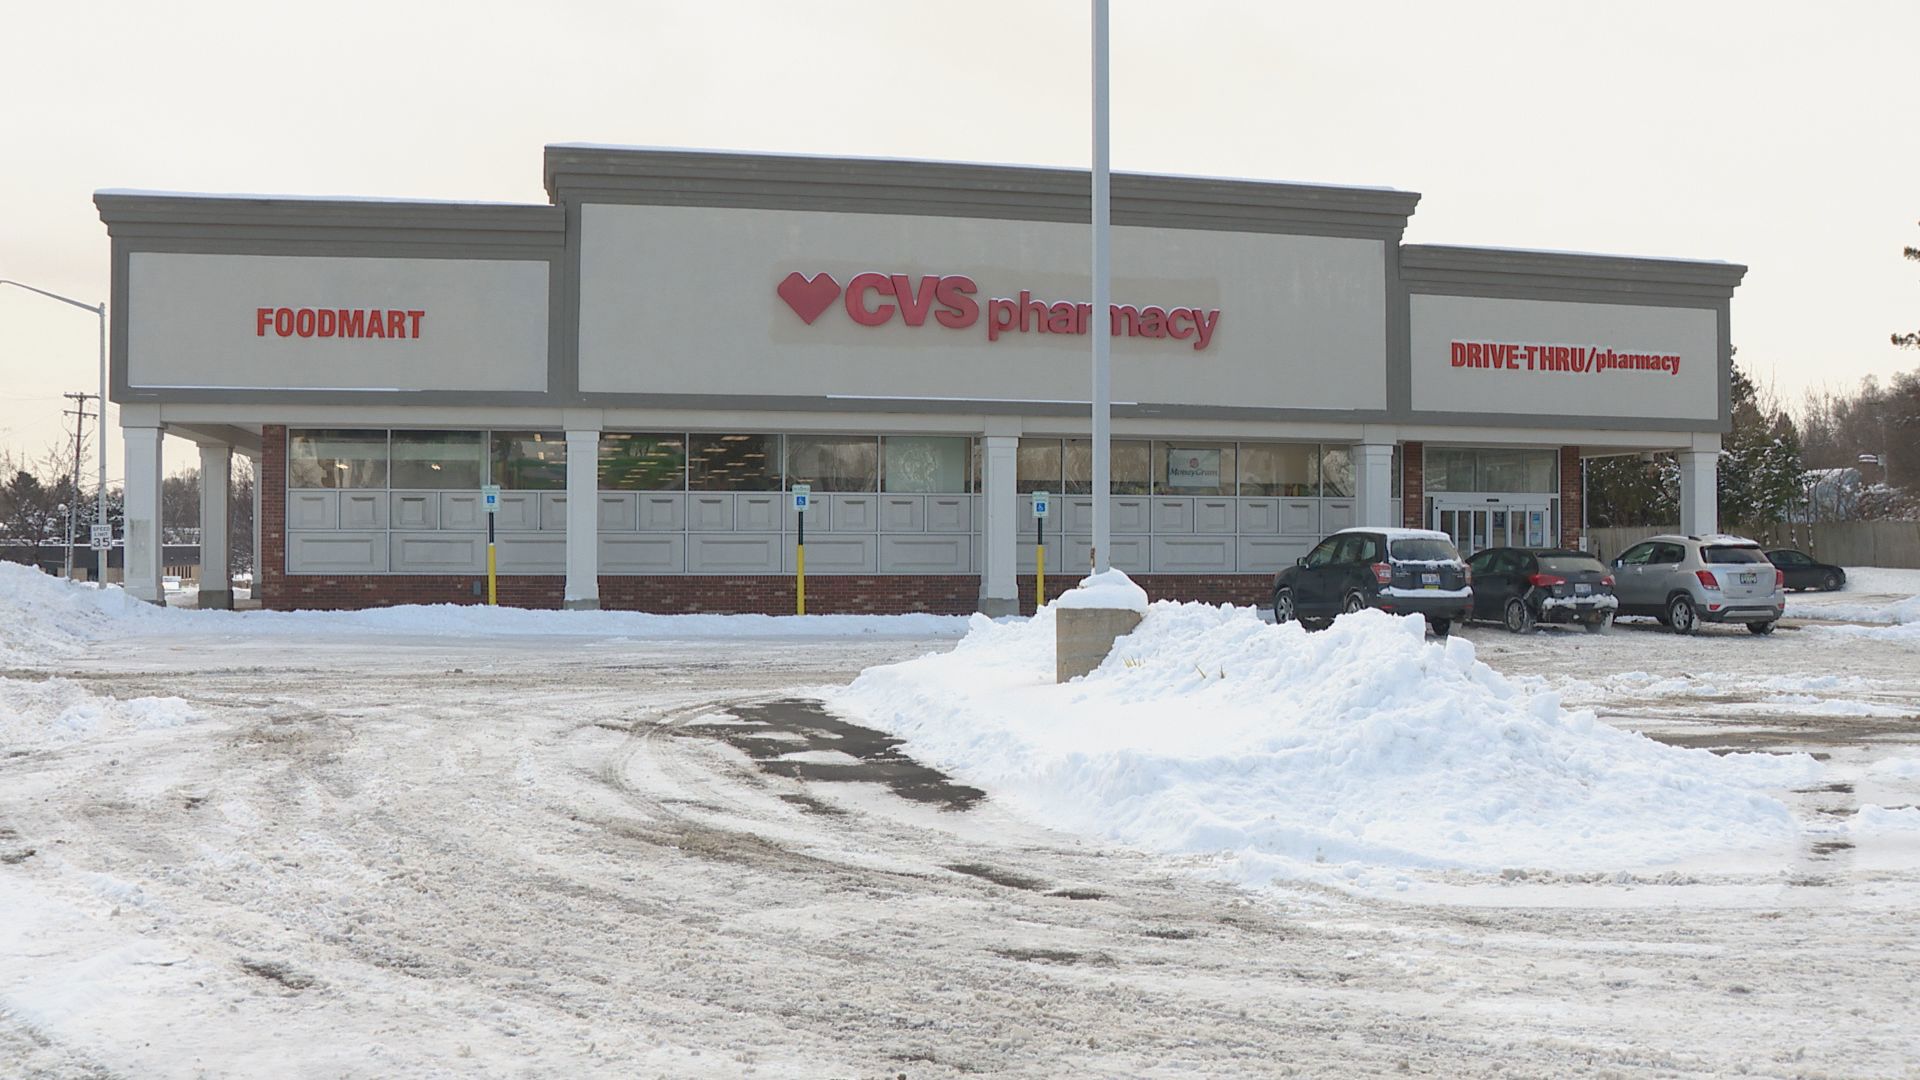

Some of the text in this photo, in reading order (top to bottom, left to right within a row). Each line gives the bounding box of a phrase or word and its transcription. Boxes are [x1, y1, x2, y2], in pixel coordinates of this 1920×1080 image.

[256, 307, 425, 339] FOODMART
[844, 271, 1220, 351] CVS pharmacy
[1451, 341, 1681, 375] DRIVE-THRU/pharmacy
[94, 538, 110, 548] 35
